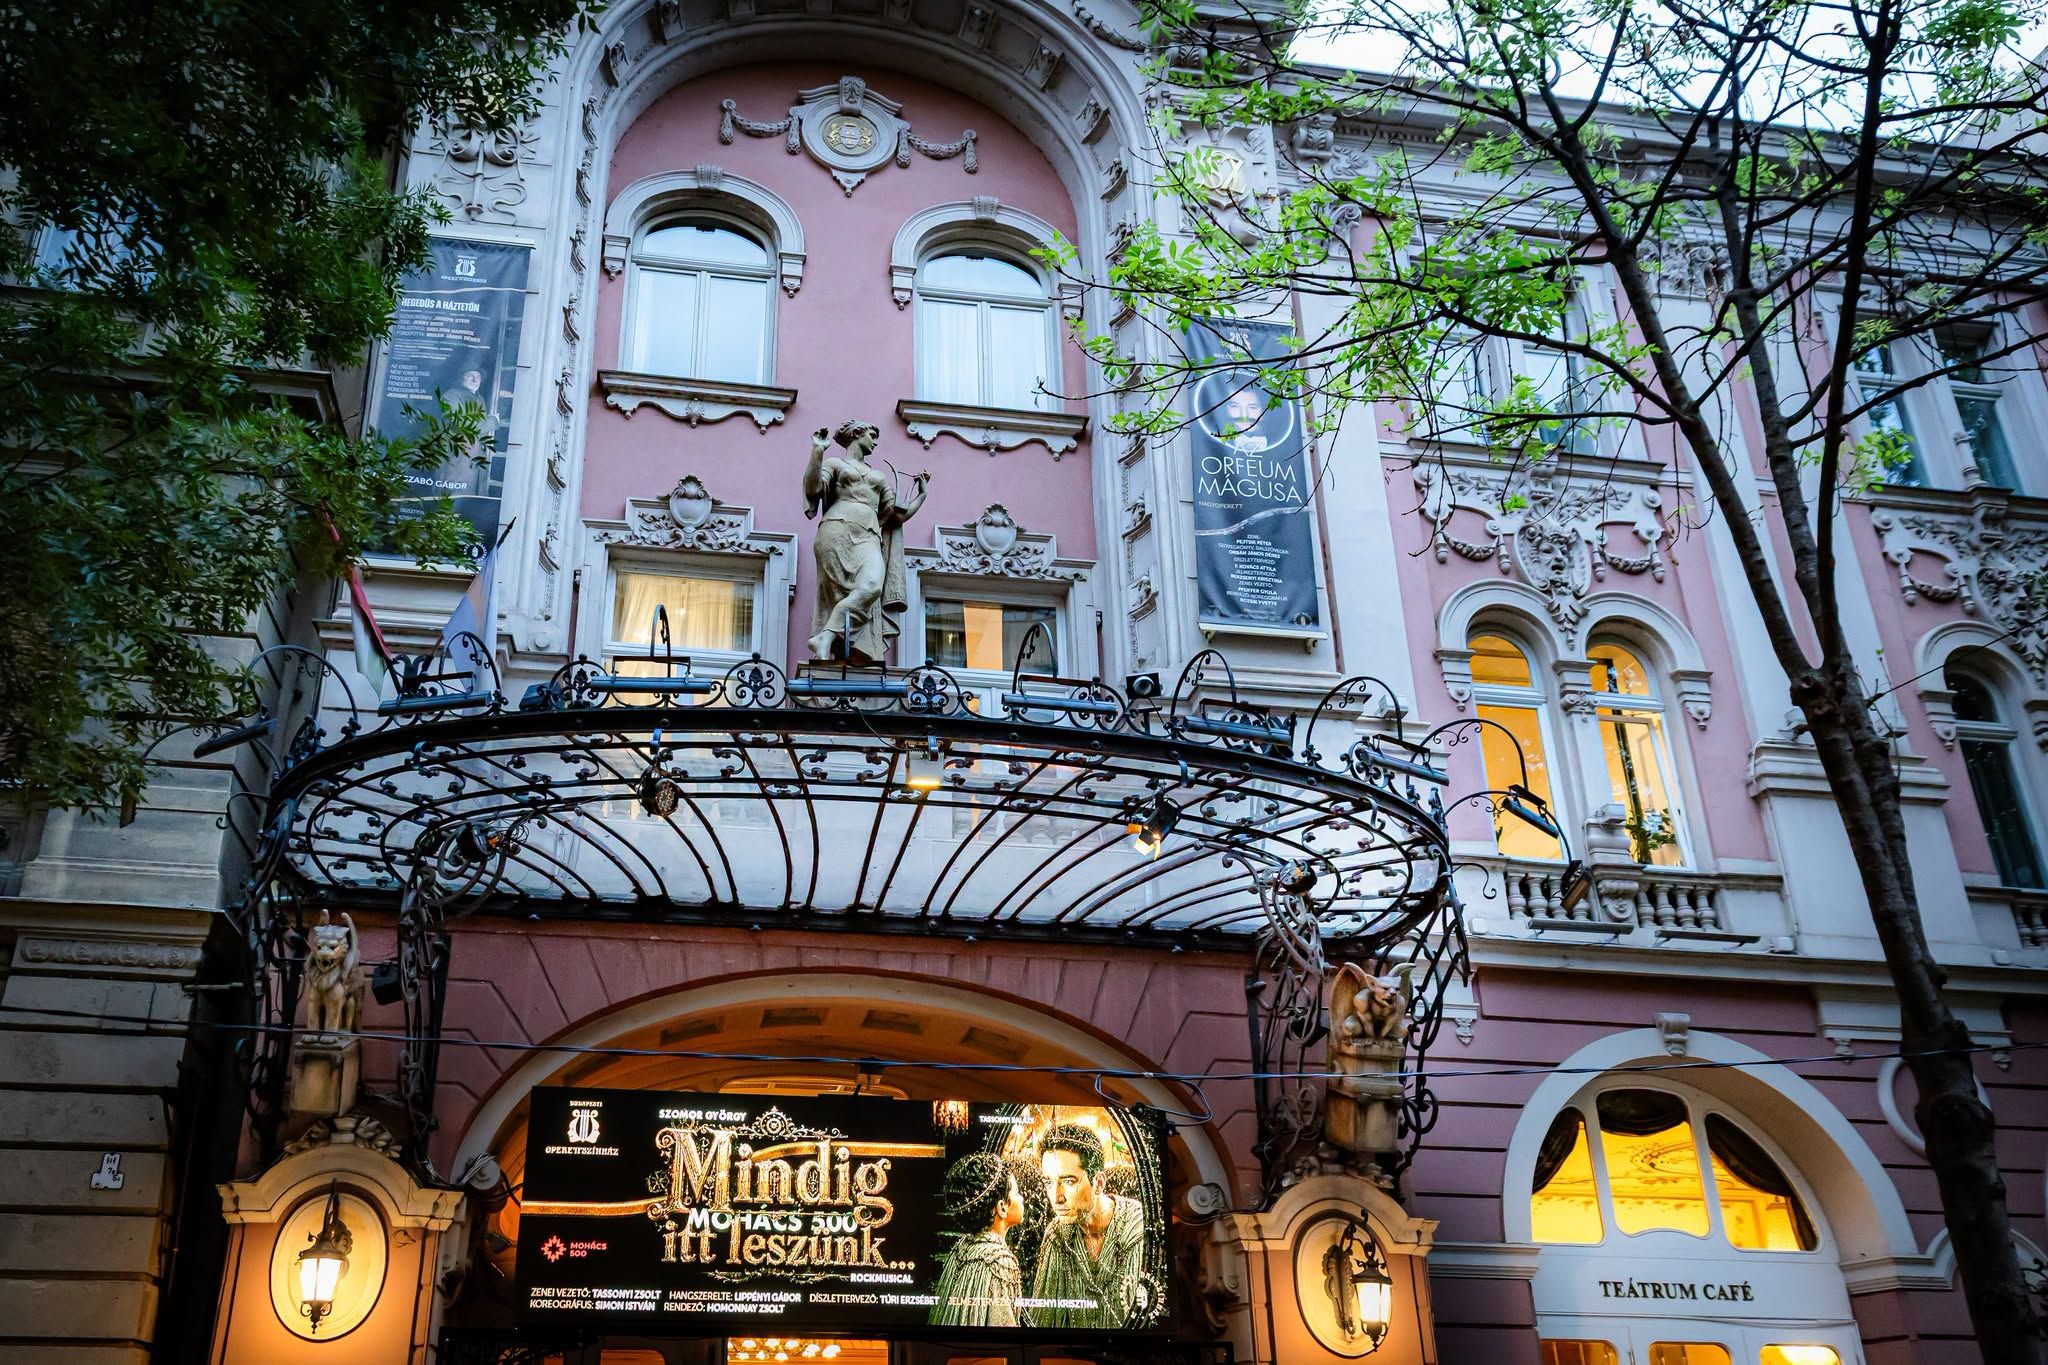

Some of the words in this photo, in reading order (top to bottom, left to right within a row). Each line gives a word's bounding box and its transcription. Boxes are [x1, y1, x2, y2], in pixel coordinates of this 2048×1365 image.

[436, 300, 442, 310] A
[443, 300, 480, 313] HÁZTETŐN
[1233, 440, 1263, 458] AZ
[1201, 456, 1296, 483] ORFEUM
[435, 479, 467, 490] GÁBOR
[1198, 473, 1303, 504] MÁGUSA
[658, 1109, 703, 1120] SZOMOR
[705, 1110, 747, 1122] GYÖRGY
[647, 1127, 894, 1229] Mindig
[687, 1204, 803, 1233] MOHÁCS
[811, 1212, 859, 1233] 500
[570, 1240, 608, 1250] MOHÁCS
[661, 1219, 718, 1264] itt
[726, 1212, 916, 1270] leszünk...
[850, 1272, 914, 1284] ROCKMUSICAL
[530, 1287, 555, 1297] ZENEI
[556, 1288, 591, 1298] VEZETŐ:
[592, 1288, 633, 1300] TASSONYI
[634, 1290, 662, 1300] ZSOLT
[669, 1290, 734, 1301] HANGSZERELTE:
[734, 1290, 771, 1302] LIPPÉNYI
[771, 1291, 802, 1302] GÁBOR
[809, 1292, 879, 1304] DÍSZLETTERVEZŐ:
[900, 1294, 940, 1306] ERZSÉBET
[1598, 1277, 1698, 1300] TEÁTRUM
[1703, 1280, 1754, 1302] CAFÉ
[529, 1299, 594, 1310] KOREOGRÁFUS:
[594, 1300, 625, 1310] SIMON
[625, 1300, 656, 1311] ISTVÁN
[663, 1302, 706, 1312] RENDEZŐ:
[706, 1302, 758, 1313] HOMONNAY
[758, 1304, 786, 1314] ZSOLT
